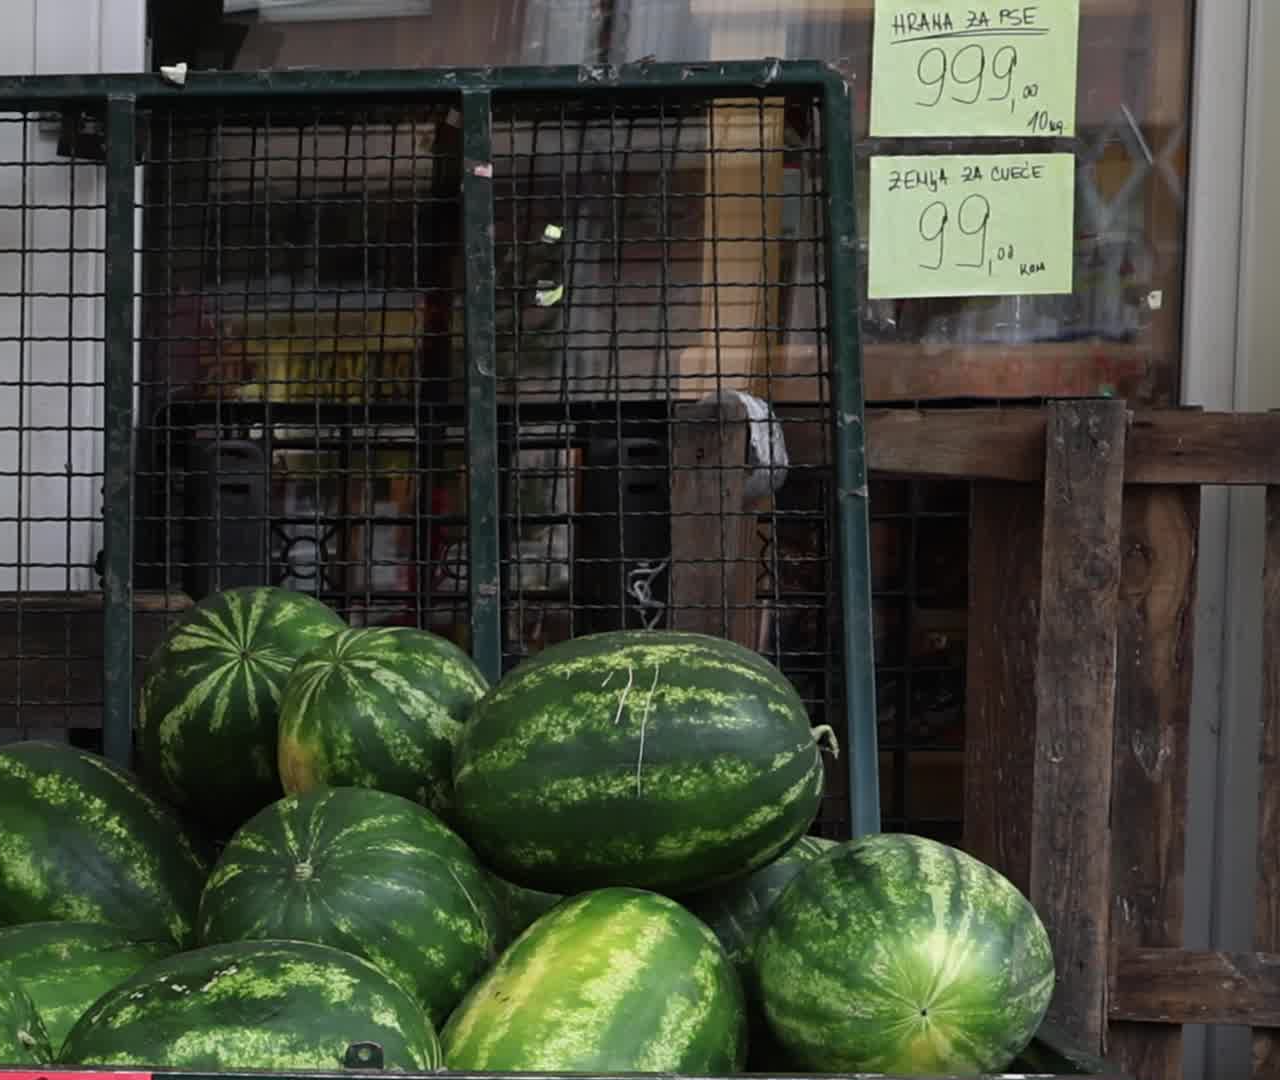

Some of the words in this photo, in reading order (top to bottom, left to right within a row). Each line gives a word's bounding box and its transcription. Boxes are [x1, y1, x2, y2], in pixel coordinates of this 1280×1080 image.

[965, 10, 990, 28] ZA
[999, 7, 1039, 26] PSE
[961, 165, 983, 182] ZA
